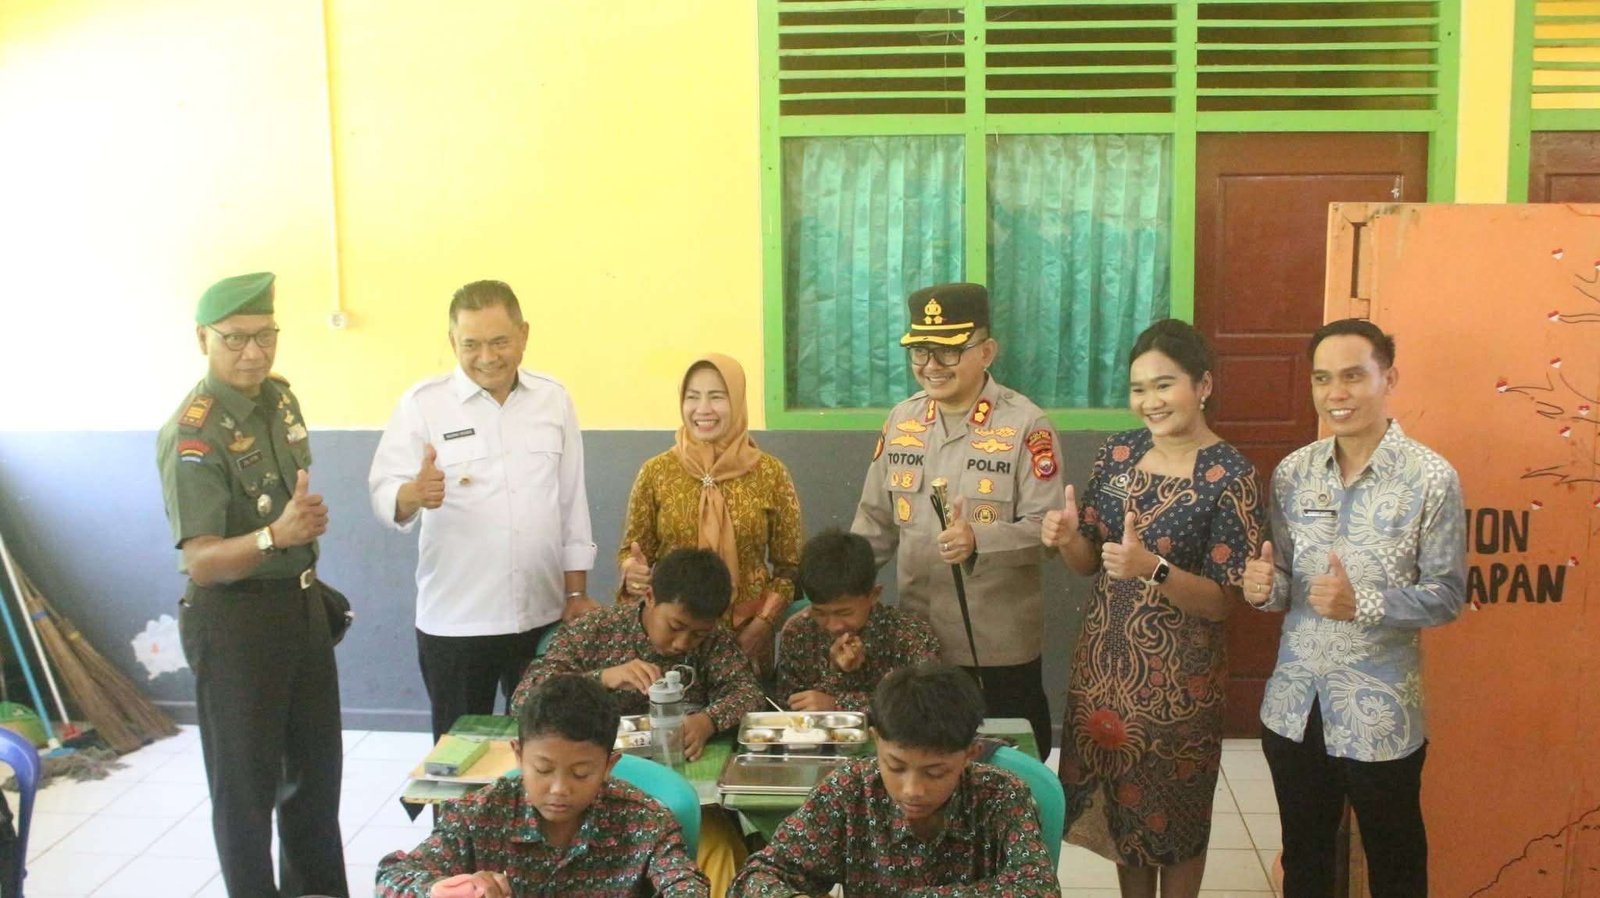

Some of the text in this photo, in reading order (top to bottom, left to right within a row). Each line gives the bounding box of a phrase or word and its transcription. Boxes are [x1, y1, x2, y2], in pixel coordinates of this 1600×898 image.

[888, 453, 924, 466] TOTOK
[967, 459, 1011, 474] POLRI
[1465, 508, 1529, 554] ON
